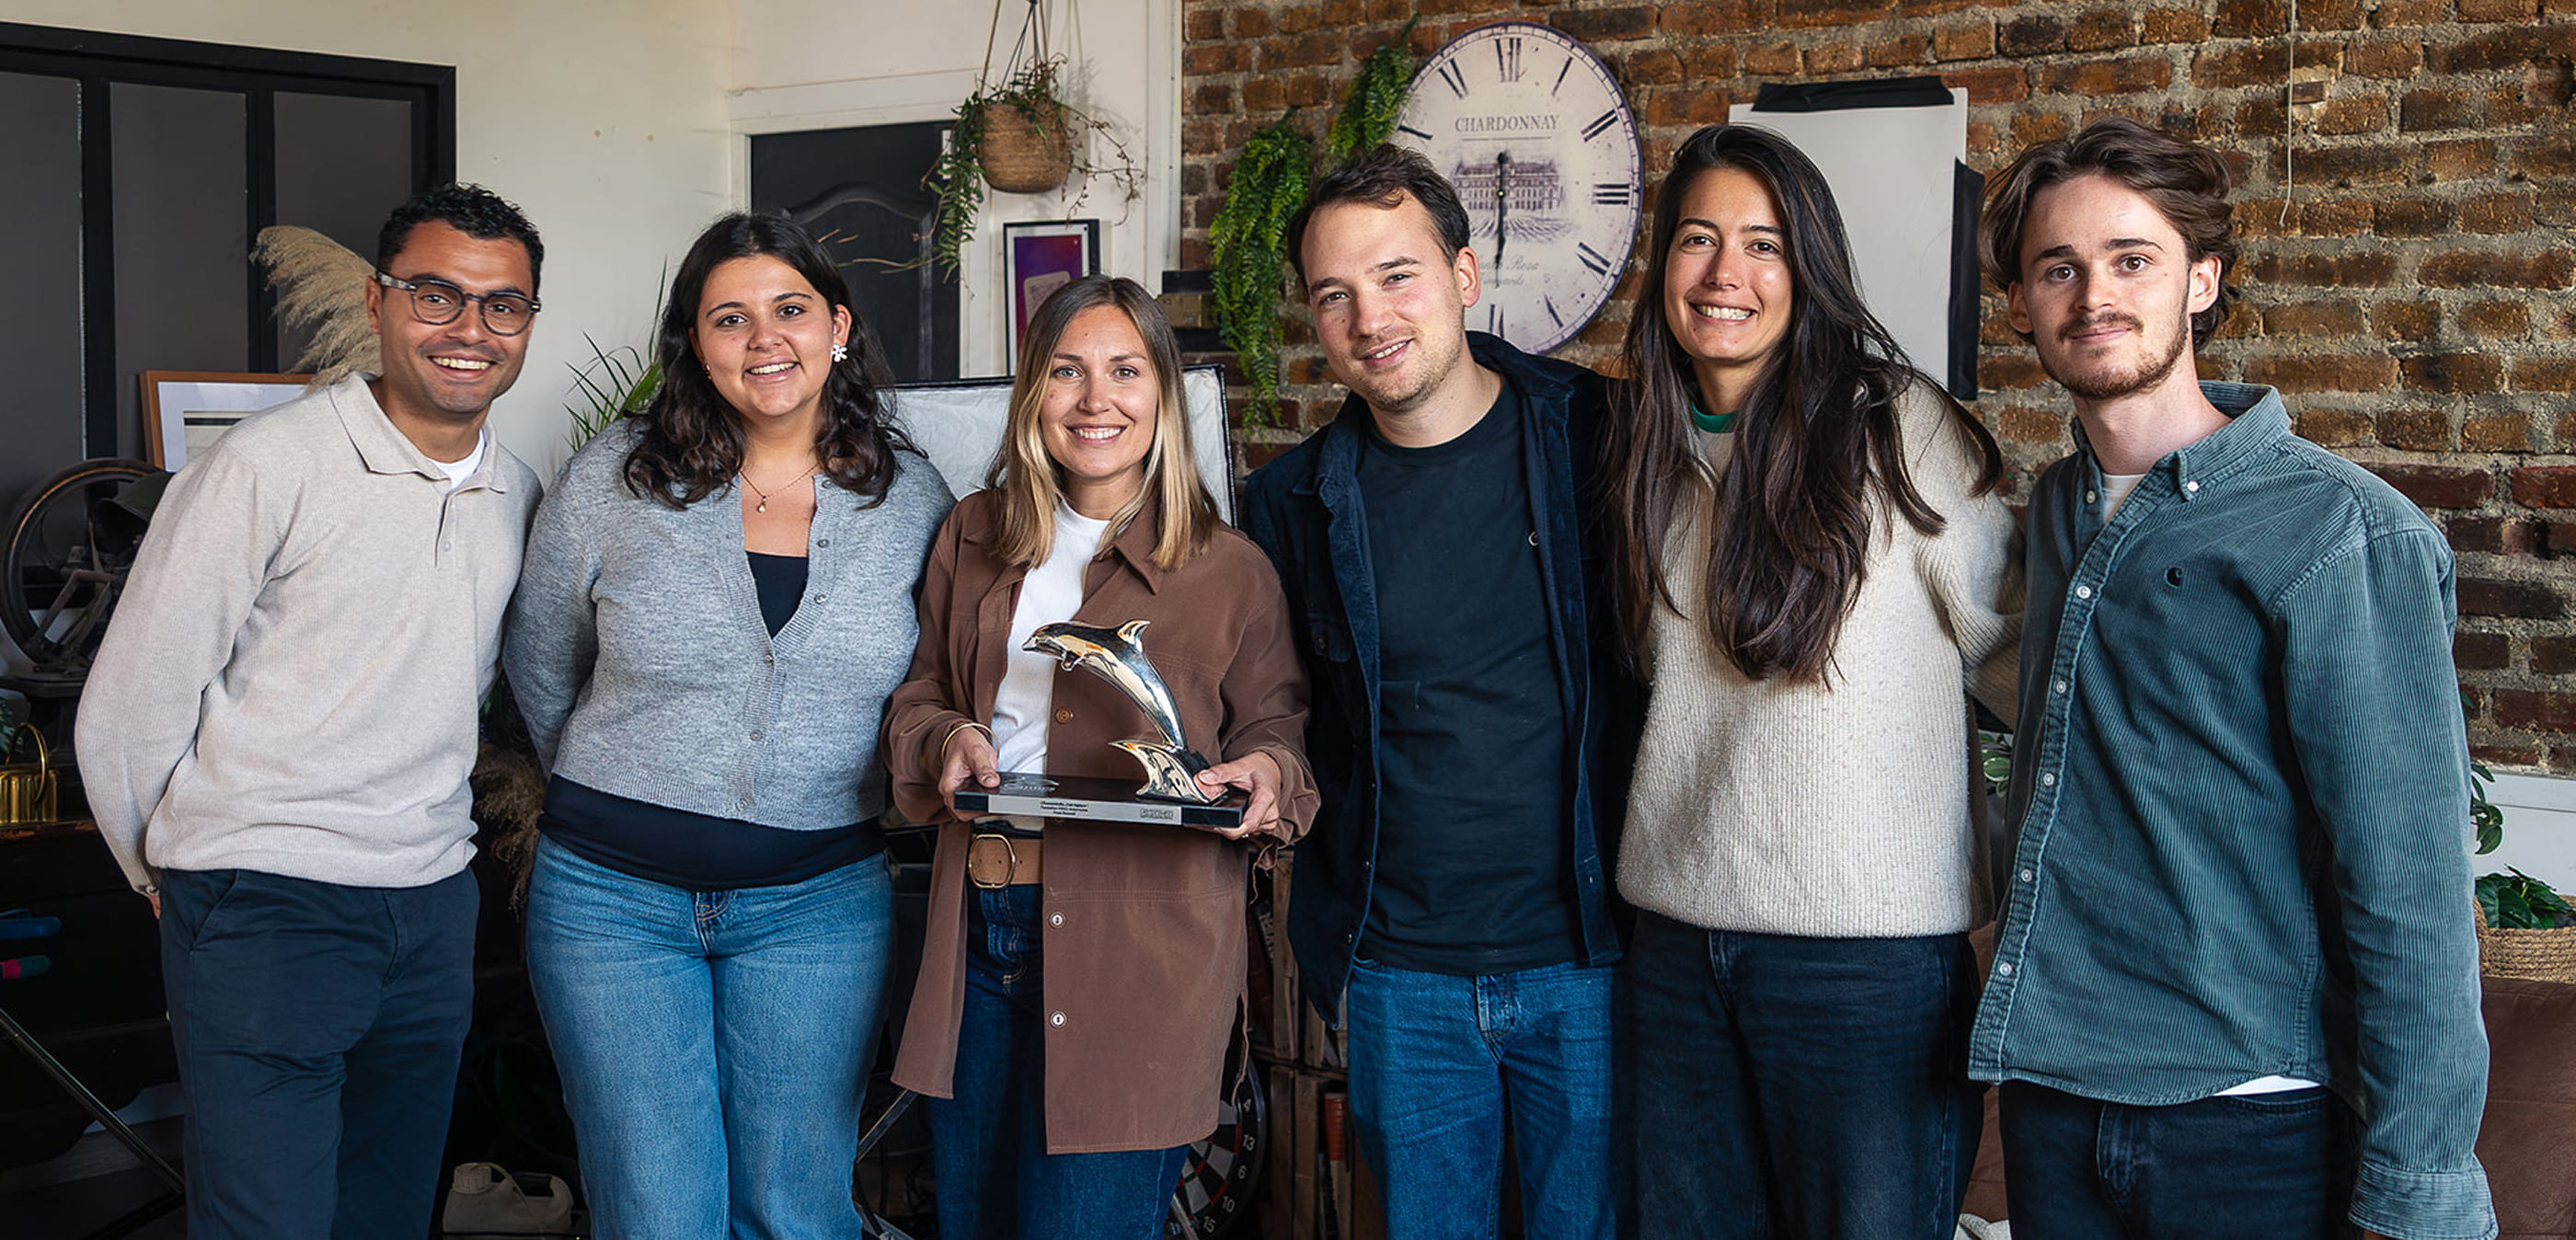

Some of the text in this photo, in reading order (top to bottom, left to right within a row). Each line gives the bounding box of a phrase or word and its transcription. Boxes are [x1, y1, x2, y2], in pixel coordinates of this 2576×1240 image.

[1455, 114, 1560, 132] CHARDONNAY
[1243, 1098, 1252, 1112] 4
[1242, 1134, 1256, 1151] 13
[1237, 1165, 1248, 1179] 6
[1222, 1196, 1236, 1213] 10
[1202, 1215, 1216, 1234] 15
